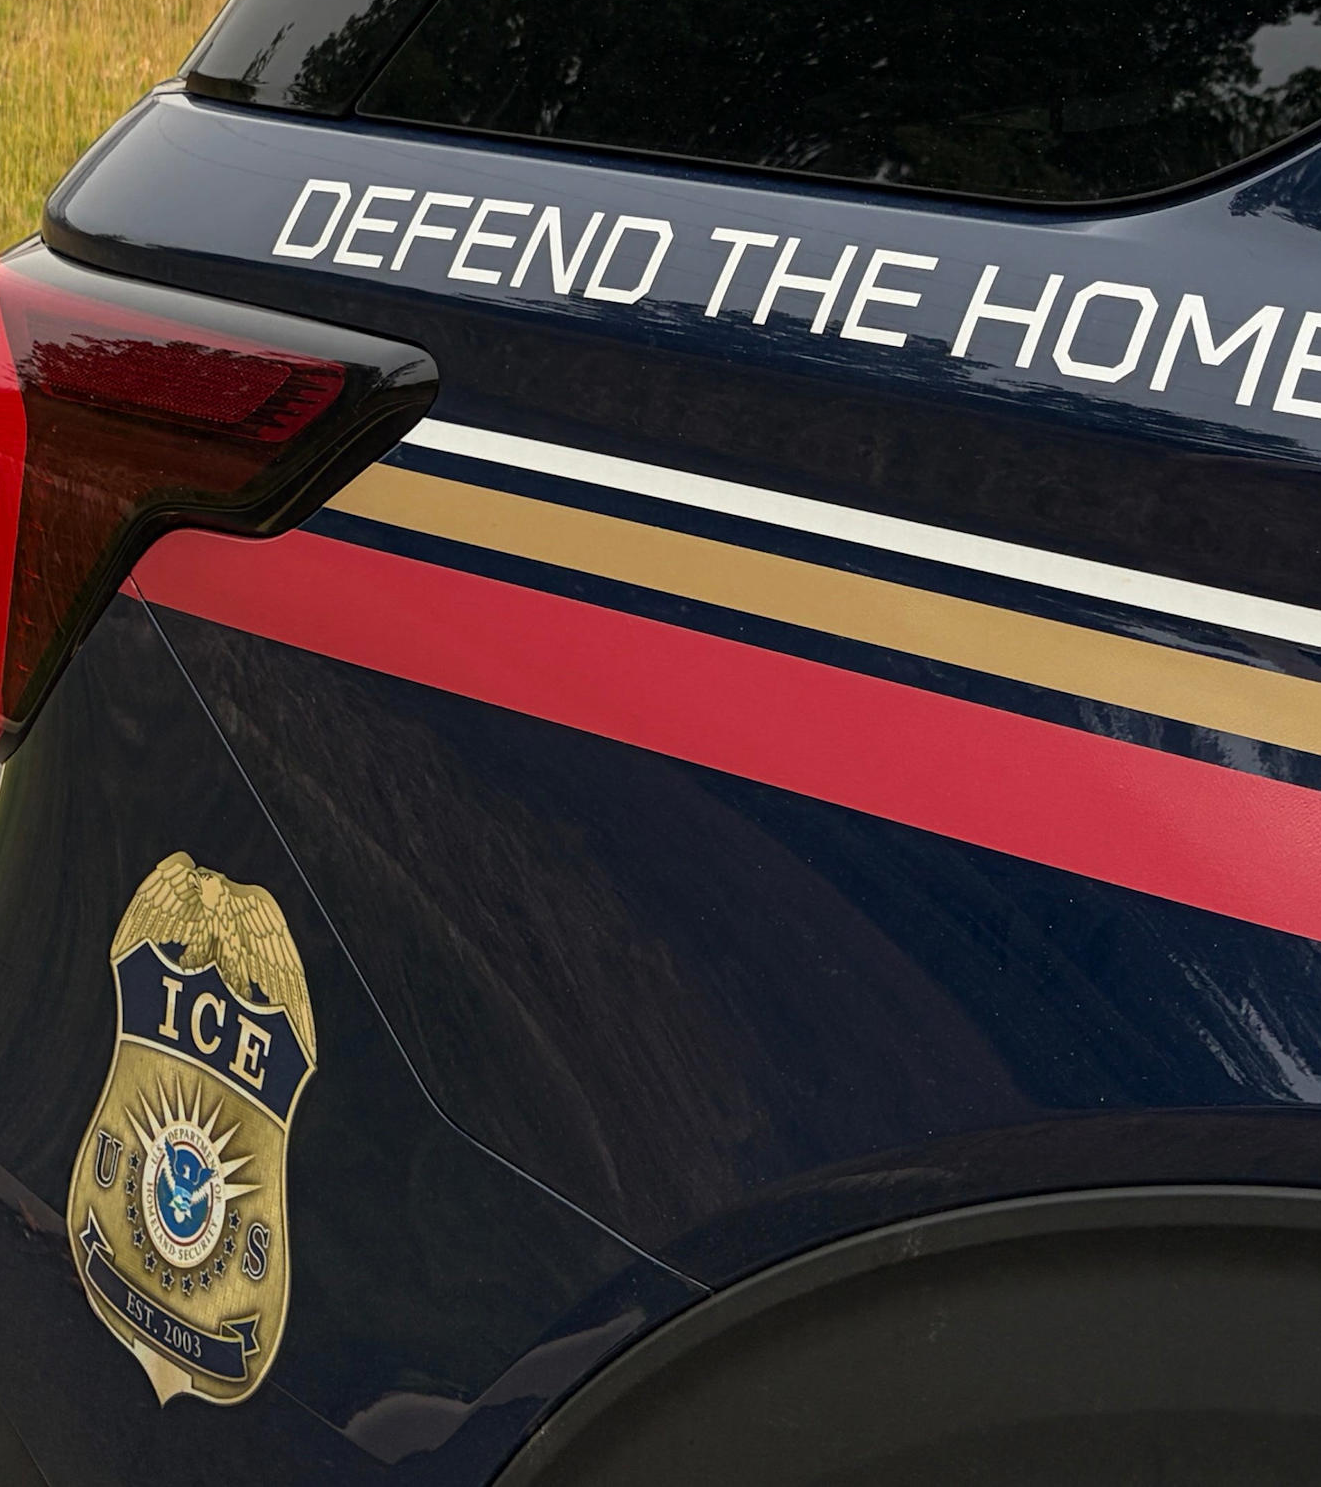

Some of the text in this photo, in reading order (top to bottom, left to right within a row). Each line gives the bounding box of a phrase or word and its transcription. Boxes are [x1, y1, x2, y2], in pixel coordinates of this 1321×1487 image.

[272, 178, 674, 305] DEFEND
[704, 227, 939, 348] THE
[158, 975, 272, 1091] ICE
[95, 1129, 124, 1188] U
[168, 1128, 219, 1179] DEPARTMENT
[214, 1183, 222, 1202] OF
[146, 1181, 218, 1261] HOMELAND SECURITY
[242, 1222, 270, 1281] S
[126, 1291, 202, 1358] EST. 2003
